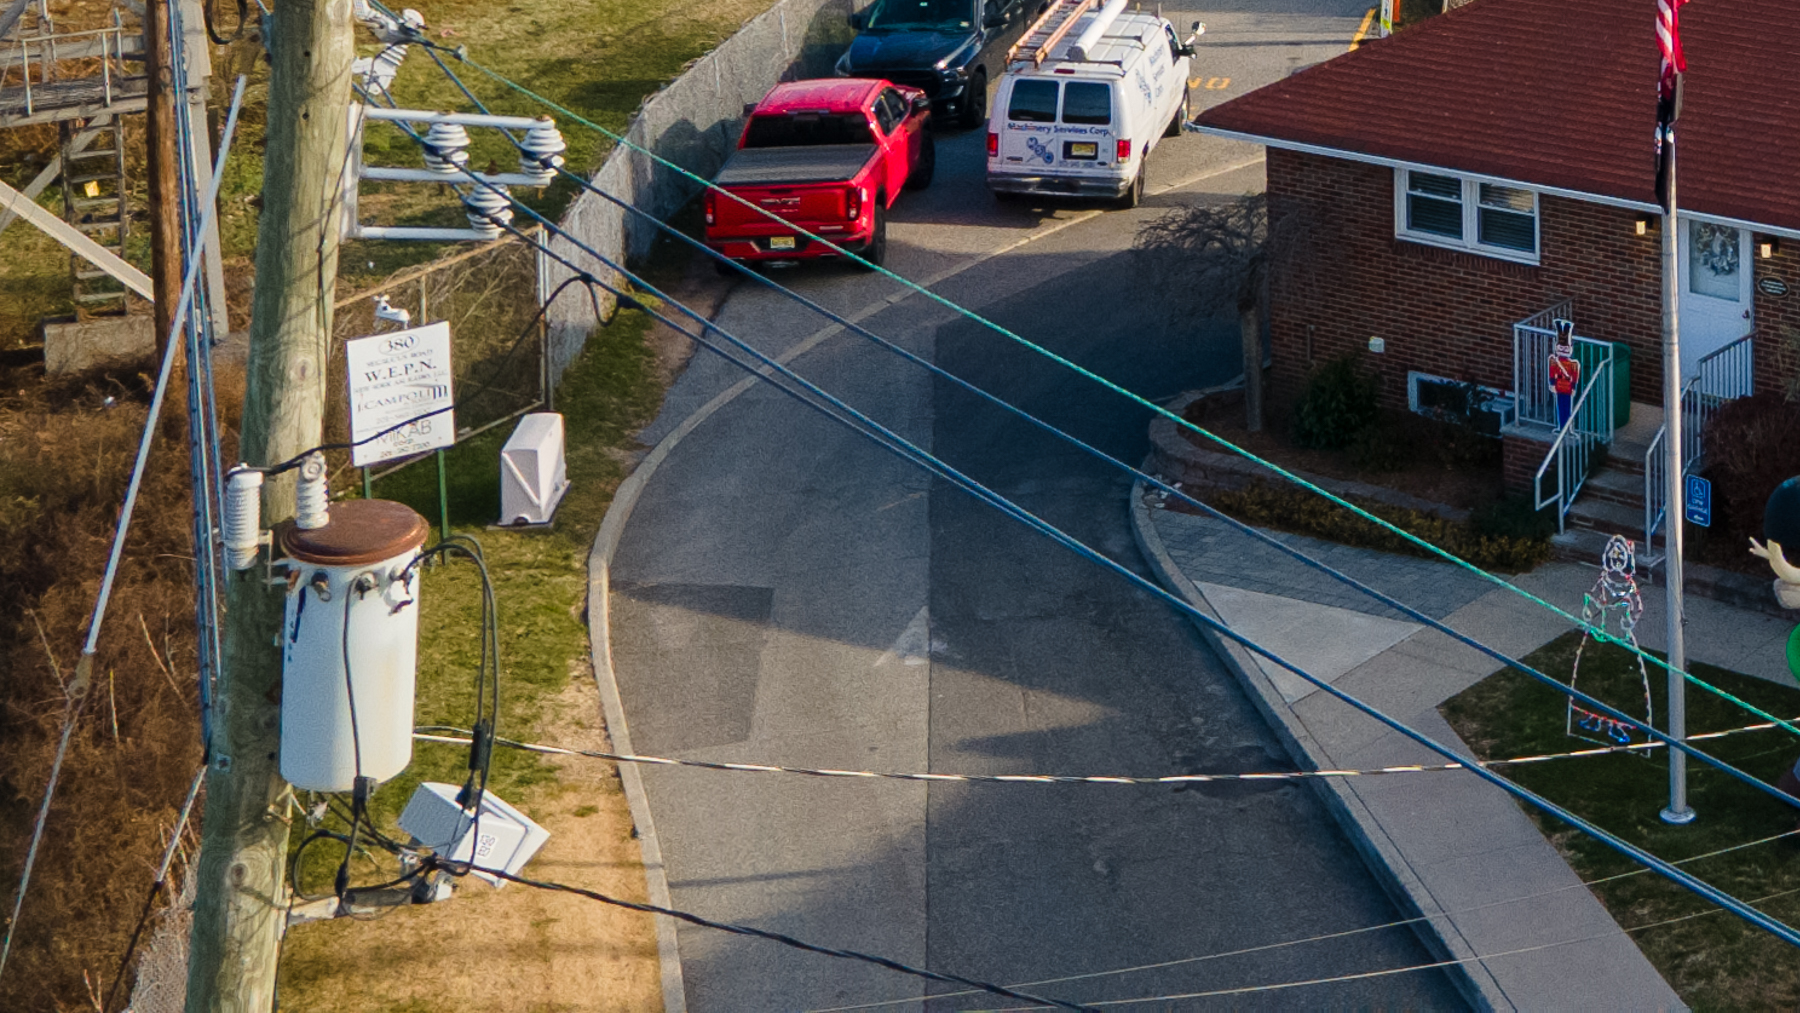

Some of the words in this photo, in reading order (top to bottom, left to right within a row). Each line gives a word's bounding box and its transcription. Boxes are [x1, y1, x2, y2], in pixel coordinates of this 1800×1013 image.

[1053, 126, 1088, 134] Services
[387, 336, 415, 352] 380
[364, 358, 437, 382] W.E.P.N.
